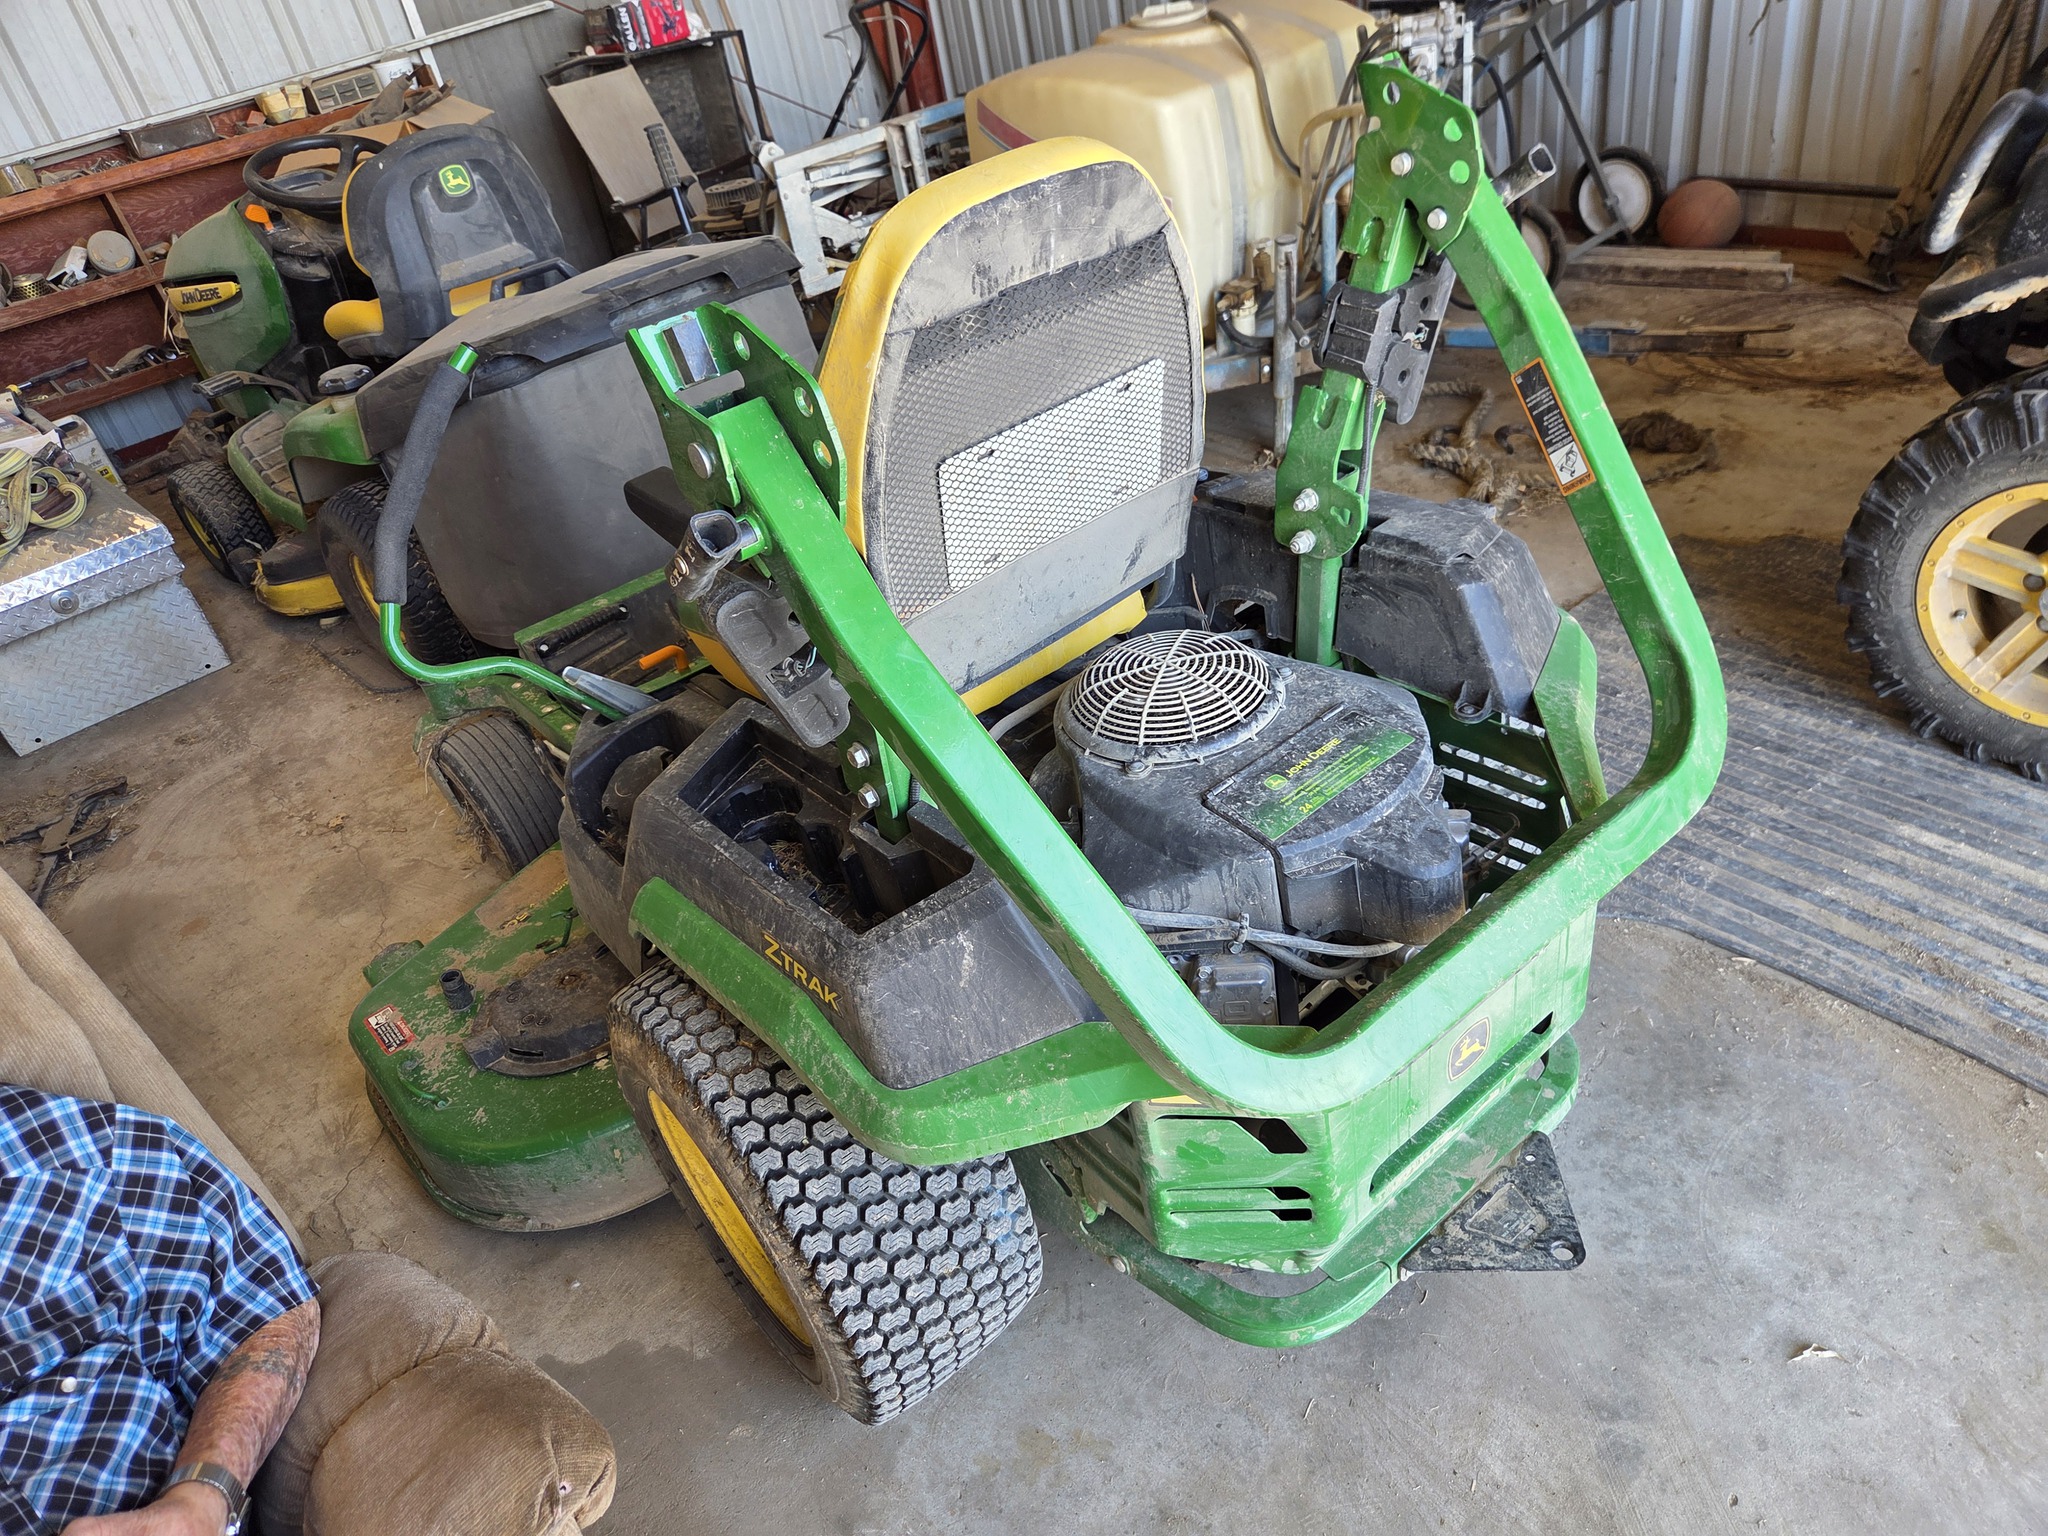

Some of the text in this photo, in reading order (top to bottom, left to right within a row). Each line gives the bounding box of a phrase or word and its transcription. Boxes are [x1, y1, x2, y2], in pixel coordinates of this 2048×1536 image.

[195, 287, 222, 302] DEERE
[1284, 737, 1342, 778] JOHN DEERE
[763, 934, 839, 1012] ZTRAK
